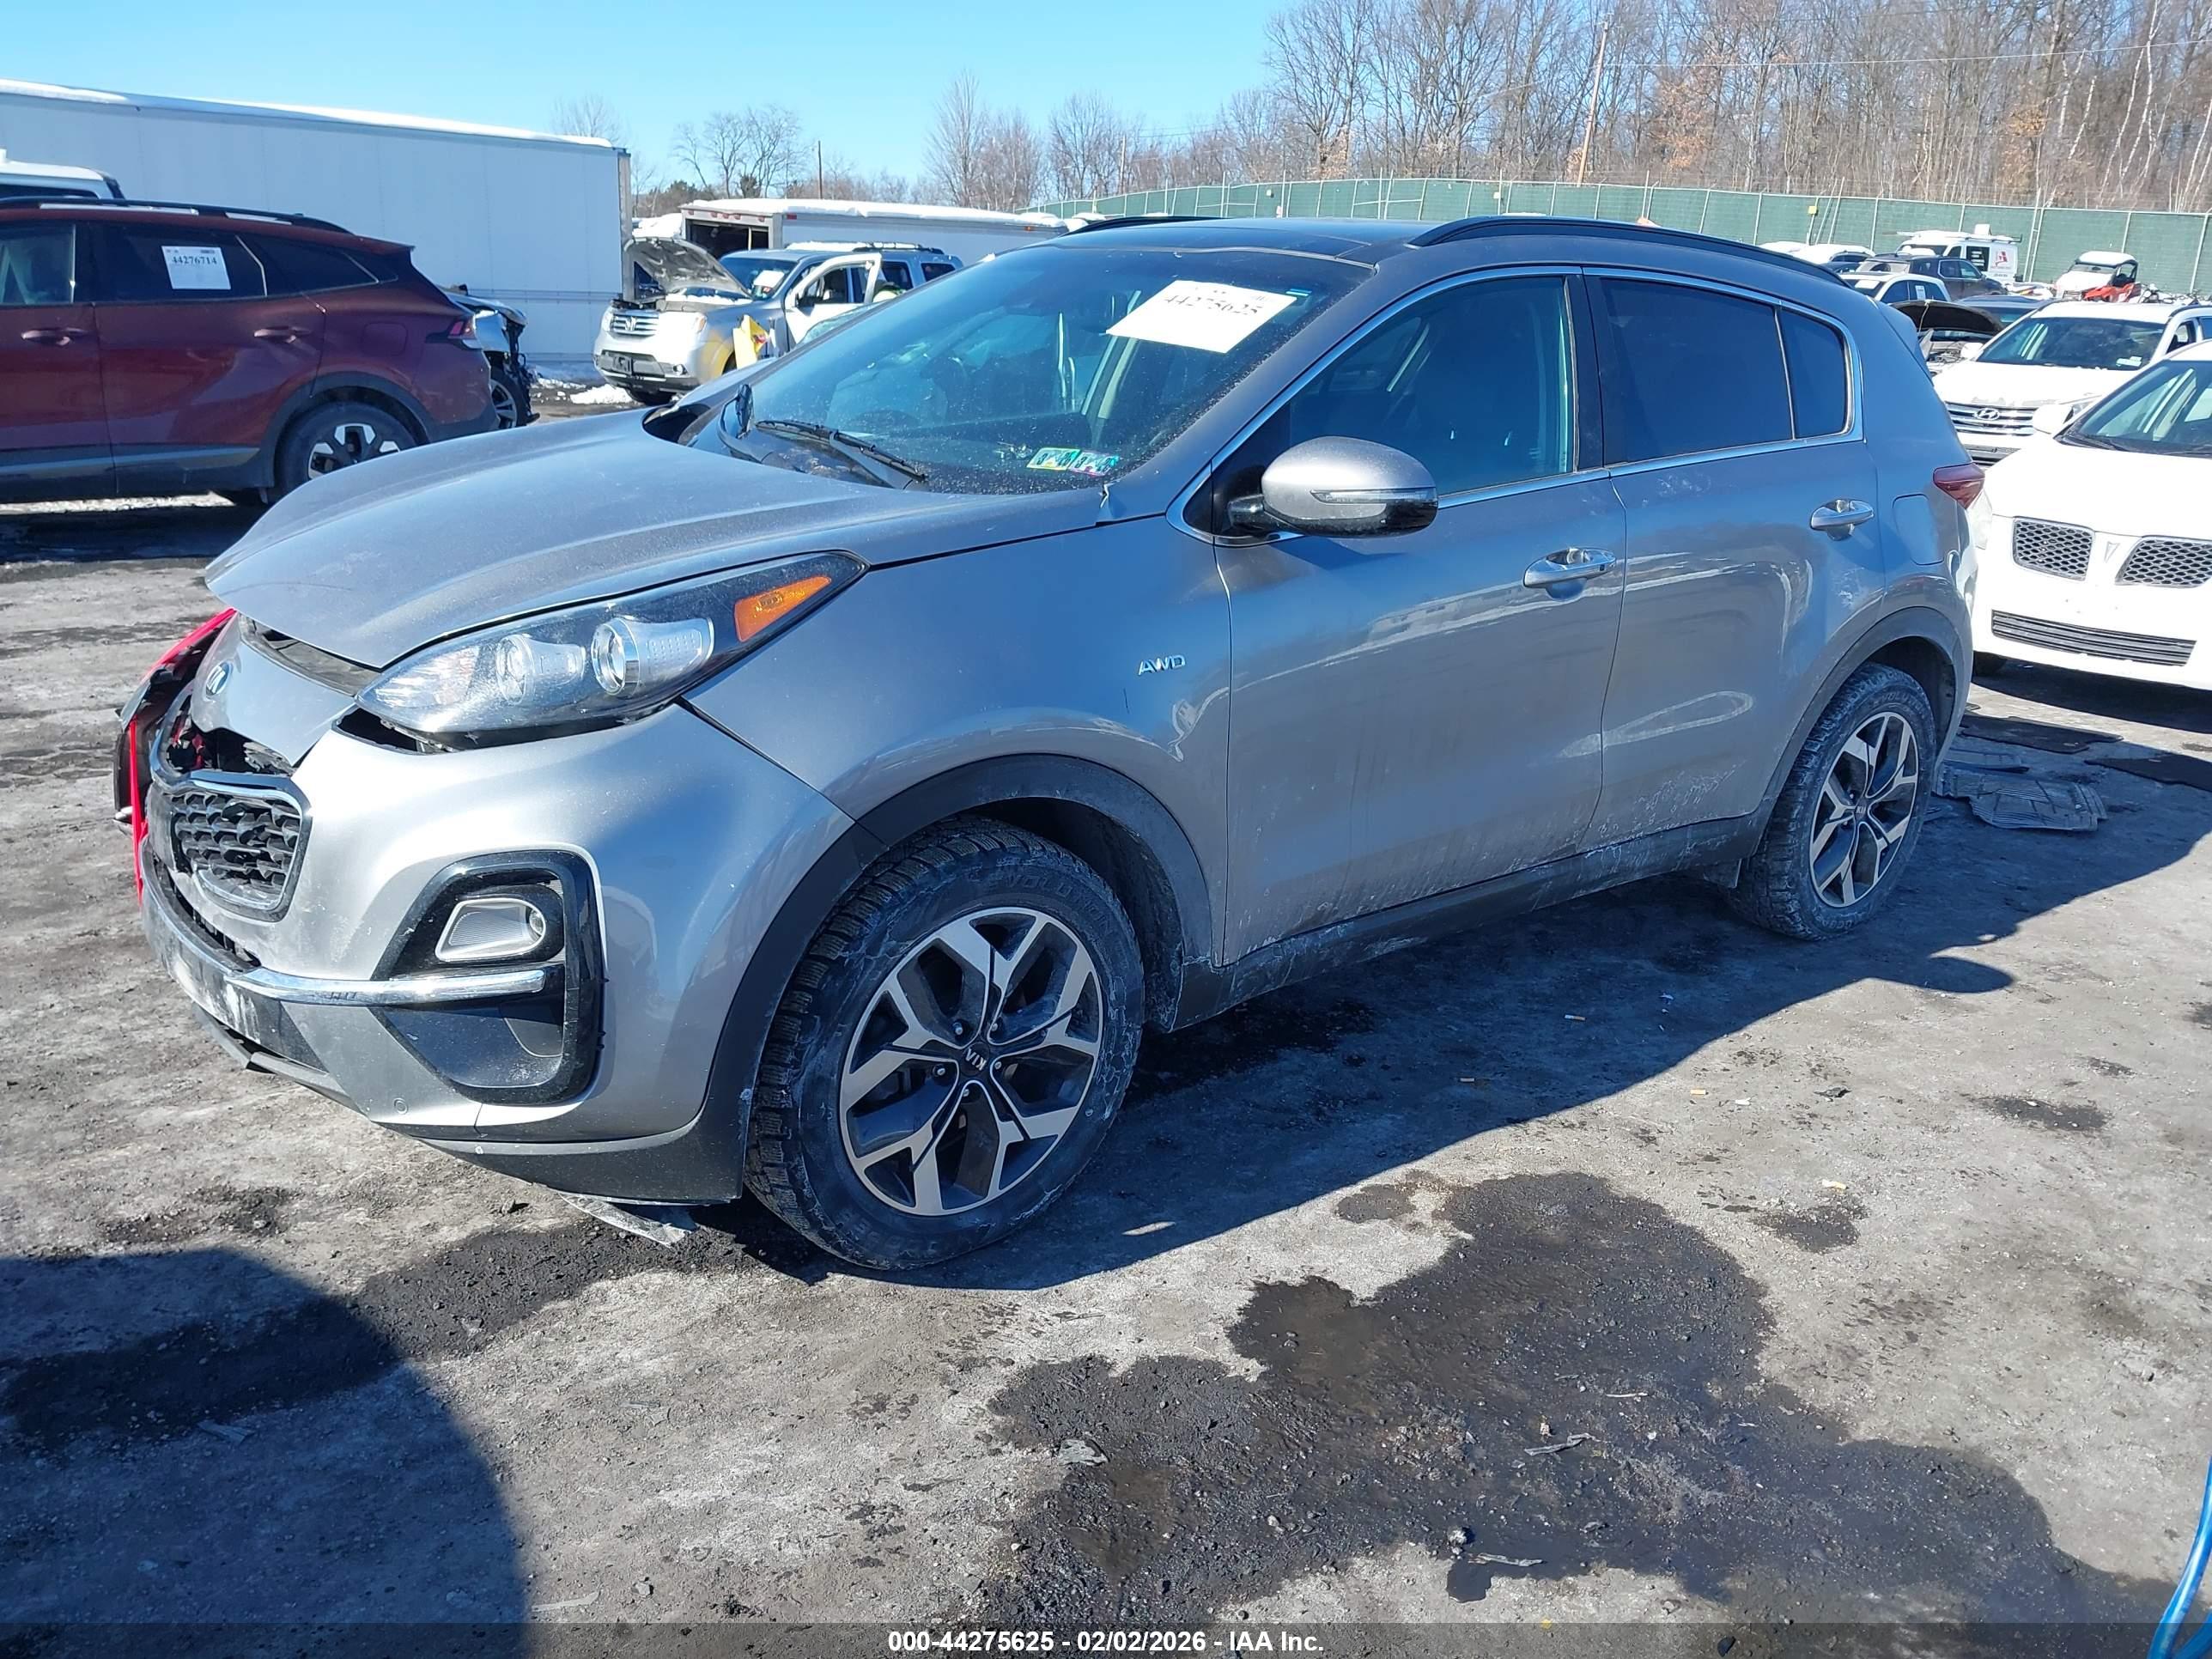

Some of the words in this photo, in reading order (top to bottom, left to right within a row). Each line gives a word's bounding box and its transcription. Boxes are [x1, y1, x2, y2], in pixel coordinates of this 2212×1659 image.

[173, 256, 217, 264] 44276714
[1138, 654, 1186, 676] AWD
[965, 1048, 987, 1071] KIA
